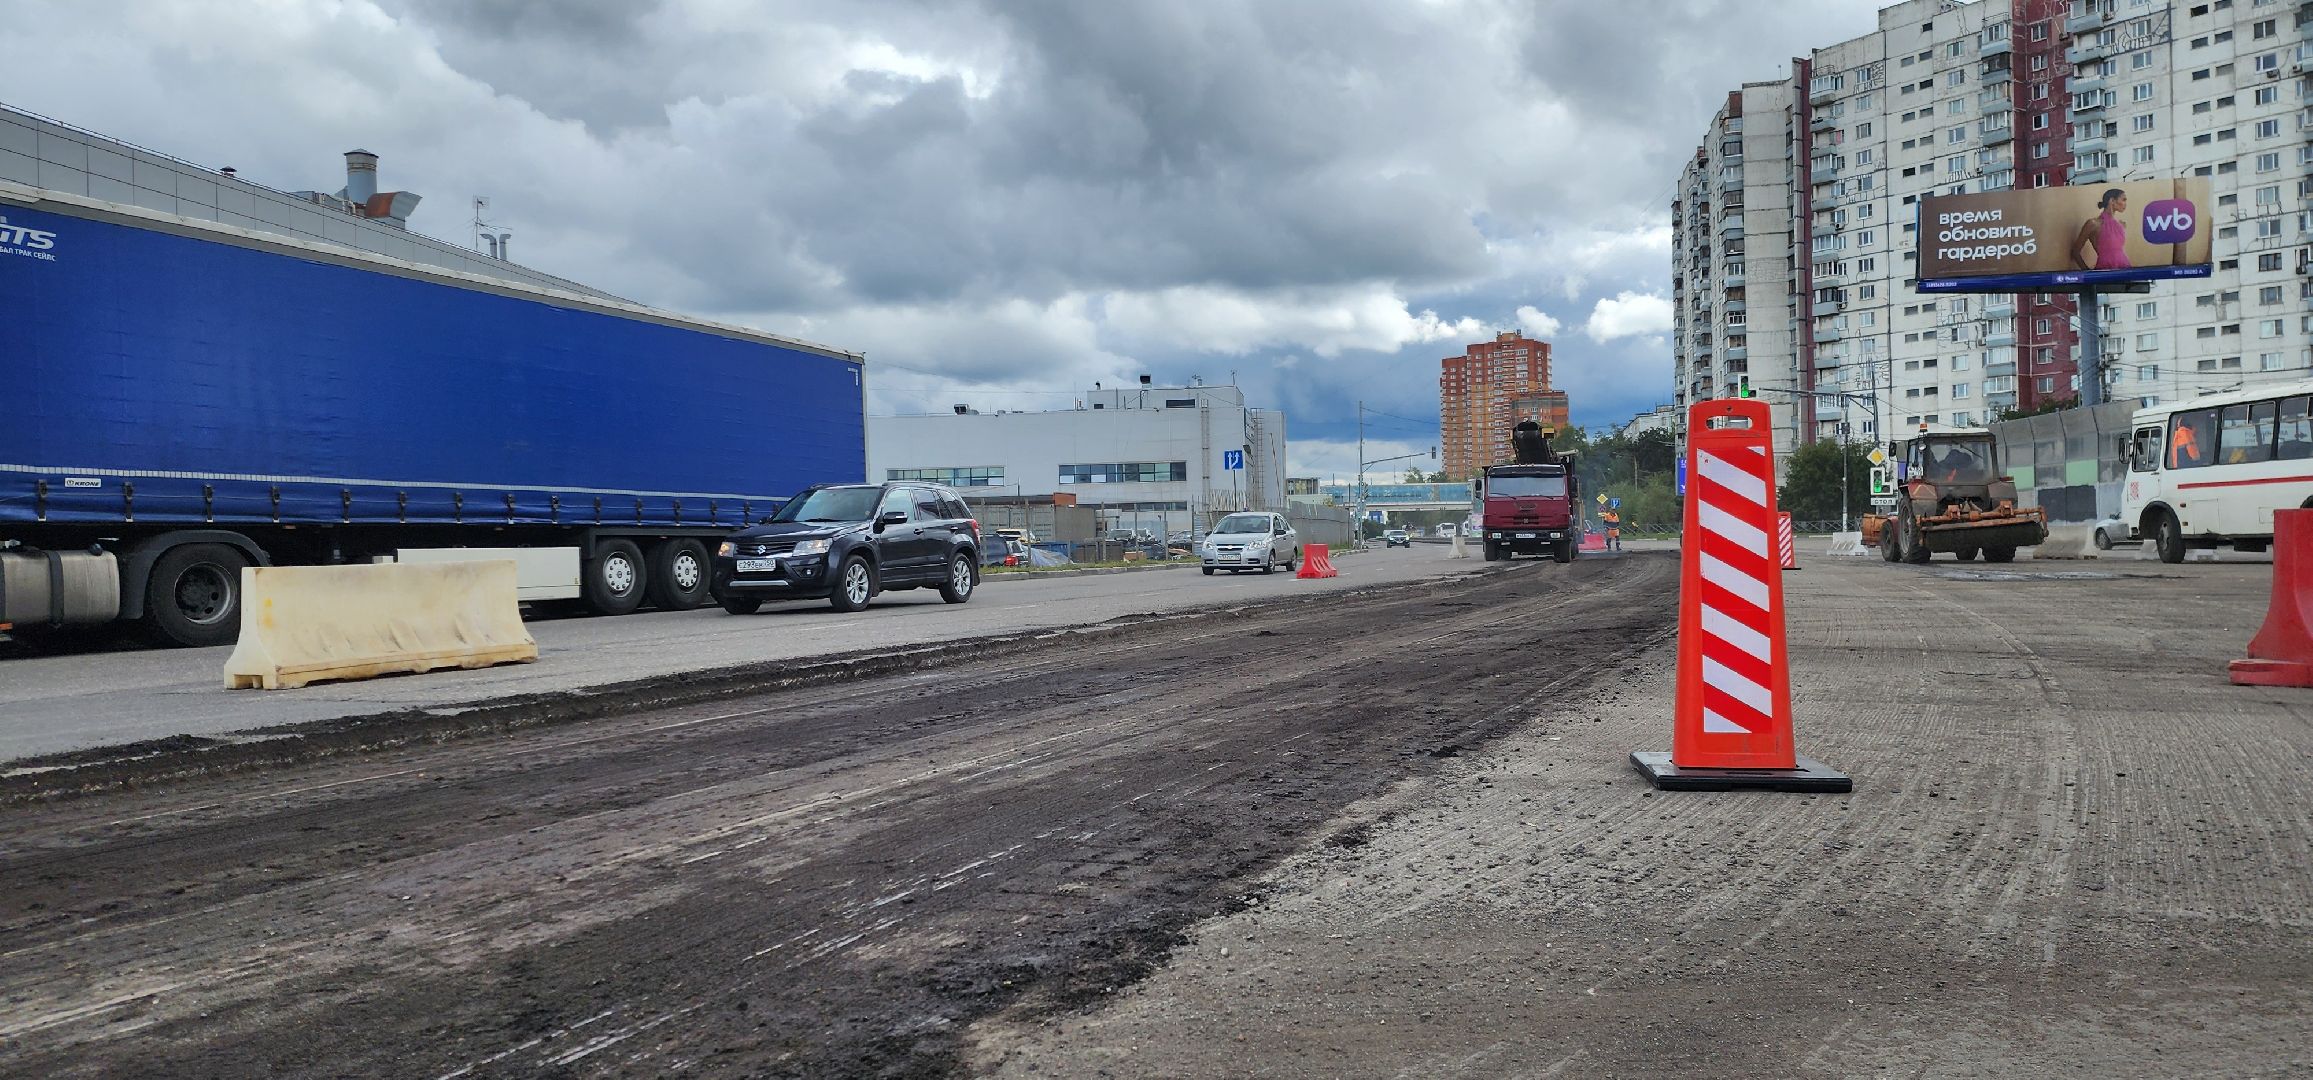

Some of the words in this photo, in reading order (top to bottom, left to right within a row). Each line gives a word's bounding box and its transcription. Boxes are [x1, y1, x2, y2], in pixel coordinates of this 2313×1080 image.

[1939, 209, 2002, 227] время
[2146, 208, 2193, 232] wb
[1939, 225, 2034, 242] обновить
[15, 249, 32, 257] ТРАК
[33, 252, 56, 261] СЕЙЛС
[1938, 238, 2037, 262] гардероб
